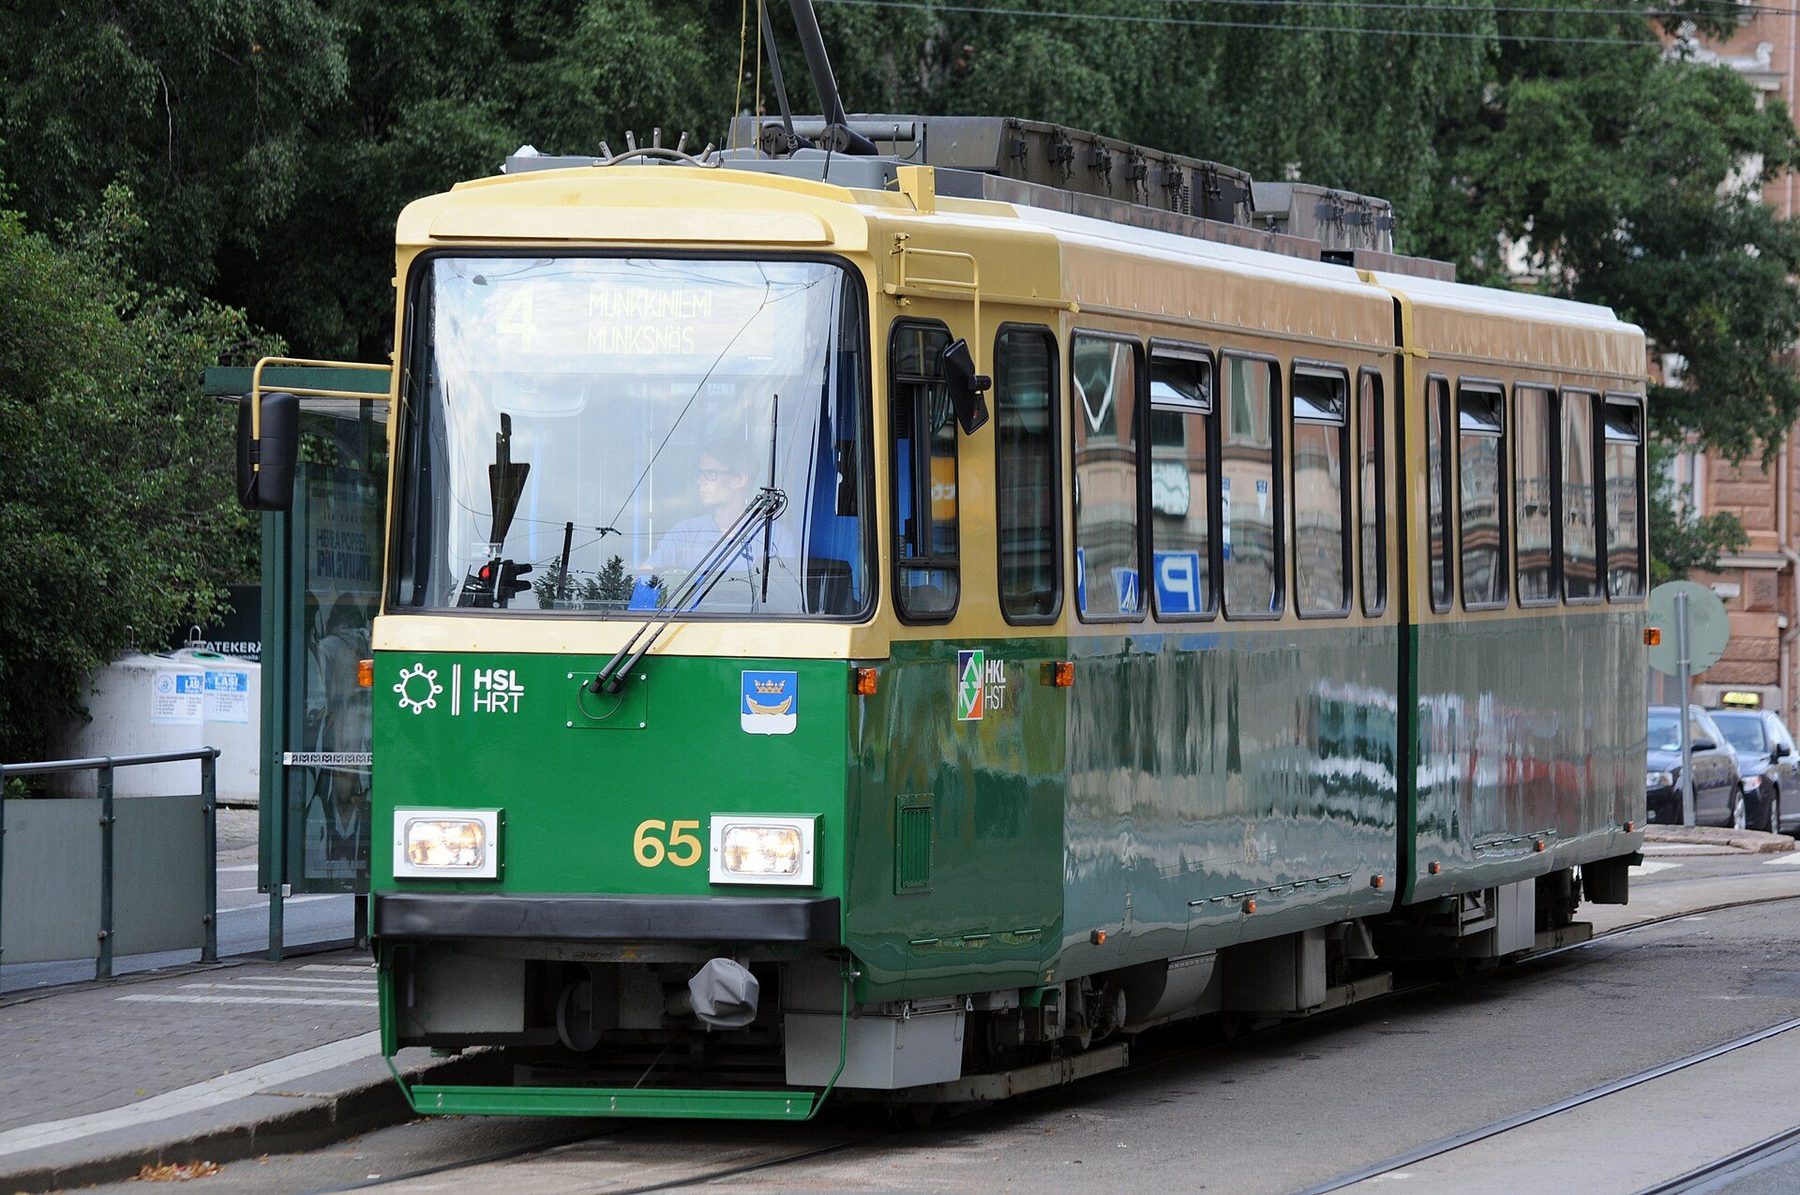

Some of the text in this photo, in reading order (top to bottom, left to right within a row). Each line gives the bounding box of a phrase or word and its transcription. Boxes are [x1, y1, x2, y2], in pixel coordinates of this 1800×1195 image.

[588, 286, 713, 320] MUNKKINIEMI
[496, 284, 537, 353] 4
[587, 323, 696, 355] MUNKSNÄS
[474, 668, 525, 691] HSL
[985, 659, 1007, 683] HKL
[473, 691, 525, 714] HRT
[984, 685, 1007, 710] HST
[633, 819, 702, 868] 65
